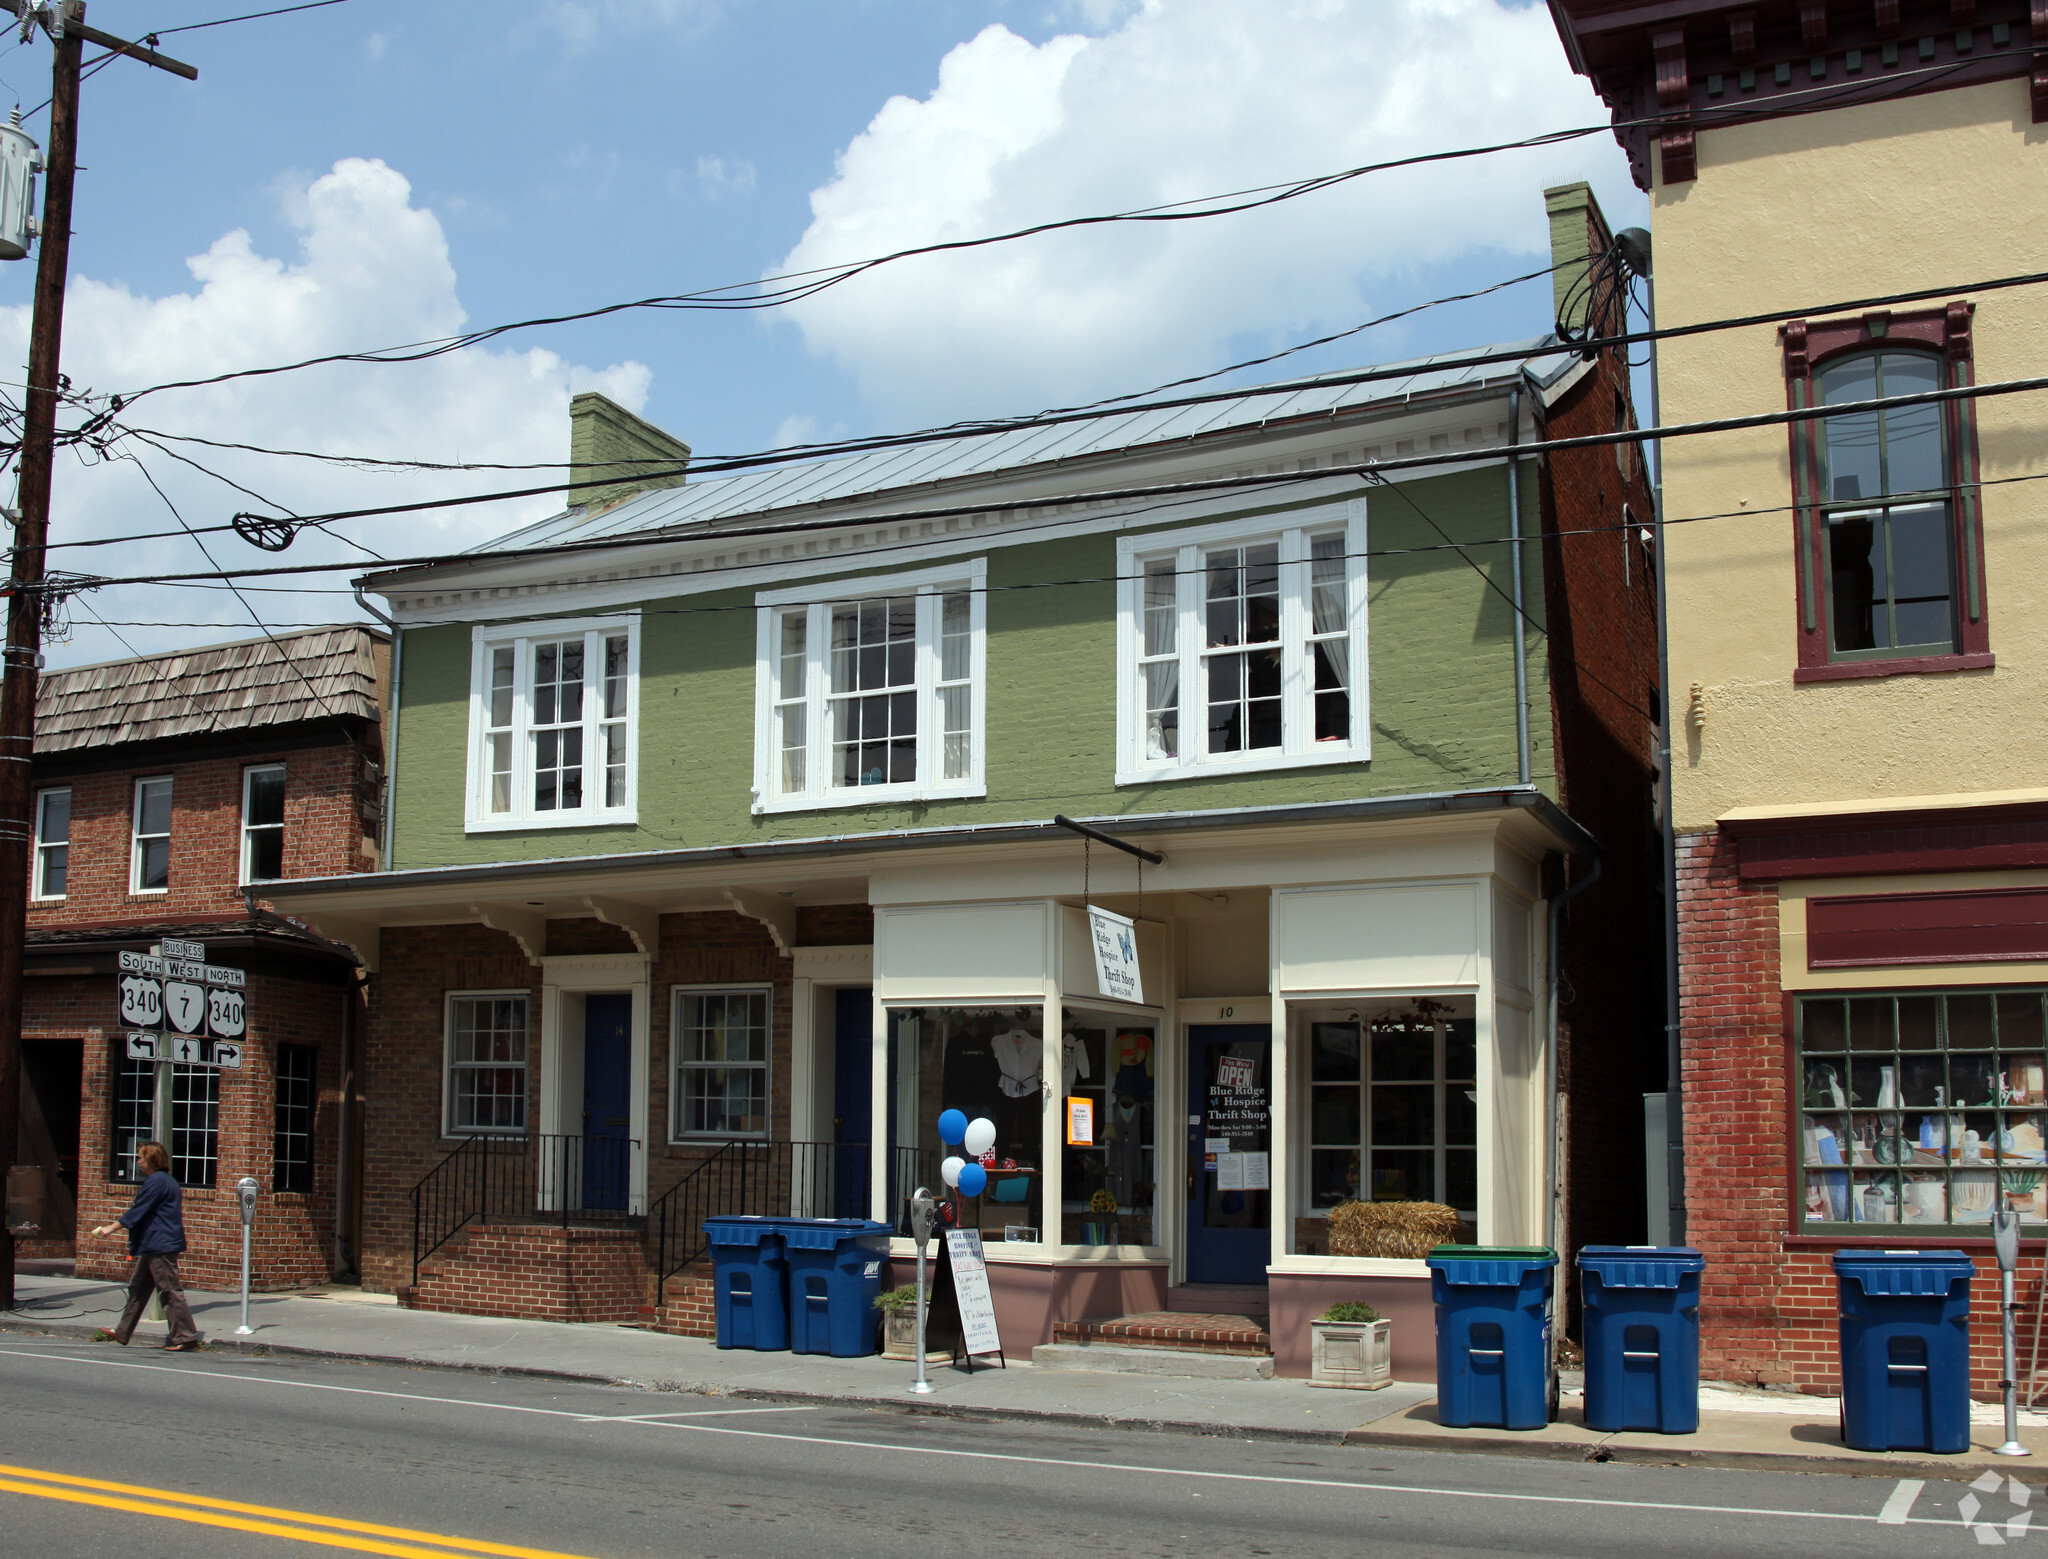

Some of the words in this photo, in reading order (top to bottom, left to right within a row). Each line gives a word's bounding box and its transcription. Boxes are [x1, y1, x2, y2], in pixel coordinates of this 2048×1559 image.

[1094, 915, 1106, 930] Blue
[1096, 930, 1111, 947] Ridge
[165, 942, 203, 957] BUSINESS
[1099, 946, 1119, 963] Hospice
[122, 954, 162, 973] SOUTH
[169, 962, 200, 978] WEST
[210, 970, 242, 983] NORTH
[1104, 966, 1121, 983] Thrift
[1121, 971, 1135, 990] Shop
[126, 988, 157, 1013] 340
[180, 997, 190, 1018] 7
[213, 1000, 240, 1025] 340
[1220, 1006, 1234, 1019] 10
[1219, 1065, 1251, 1088] OPEN
[1209, 1086, 1233, 1096] Blue
[1235, 1085, 1265, 1097] Ridge
[1224, 1096, 1266, 1109] Hospice
[1207, 1110, 1239, 1120] Thrift
[1241, 1109, 1267, 1121] Shop
